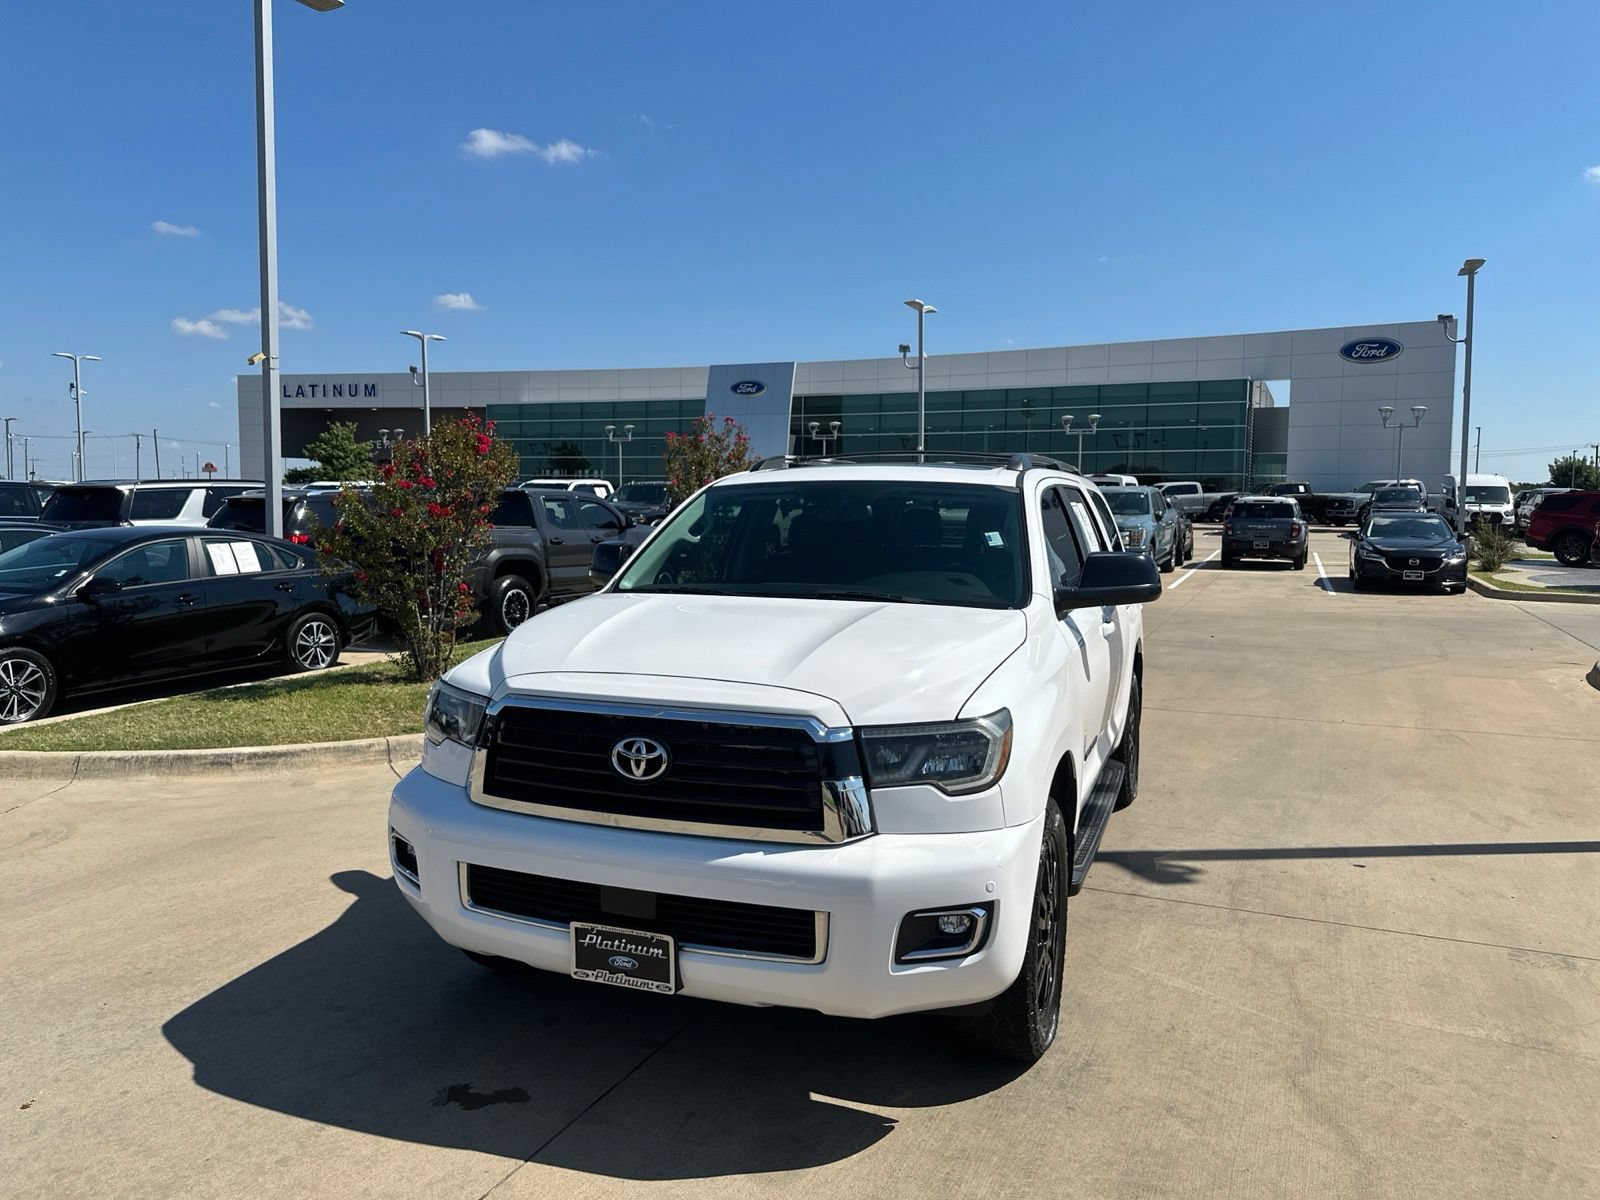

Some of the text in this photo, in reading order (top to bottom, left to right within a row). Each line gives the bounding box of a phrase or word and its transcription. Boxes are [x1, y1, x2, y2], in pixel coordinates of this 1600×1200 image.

[1352, 343, 1388, 358] Ford
[283, 383, 377, 398] LATINUM
[737, 383, 758, 393] Ford
[579, 934, 668, 959] Platinum
[614, 958, 633, 968] Ford
[594, 970, 654, 990] Platinum
